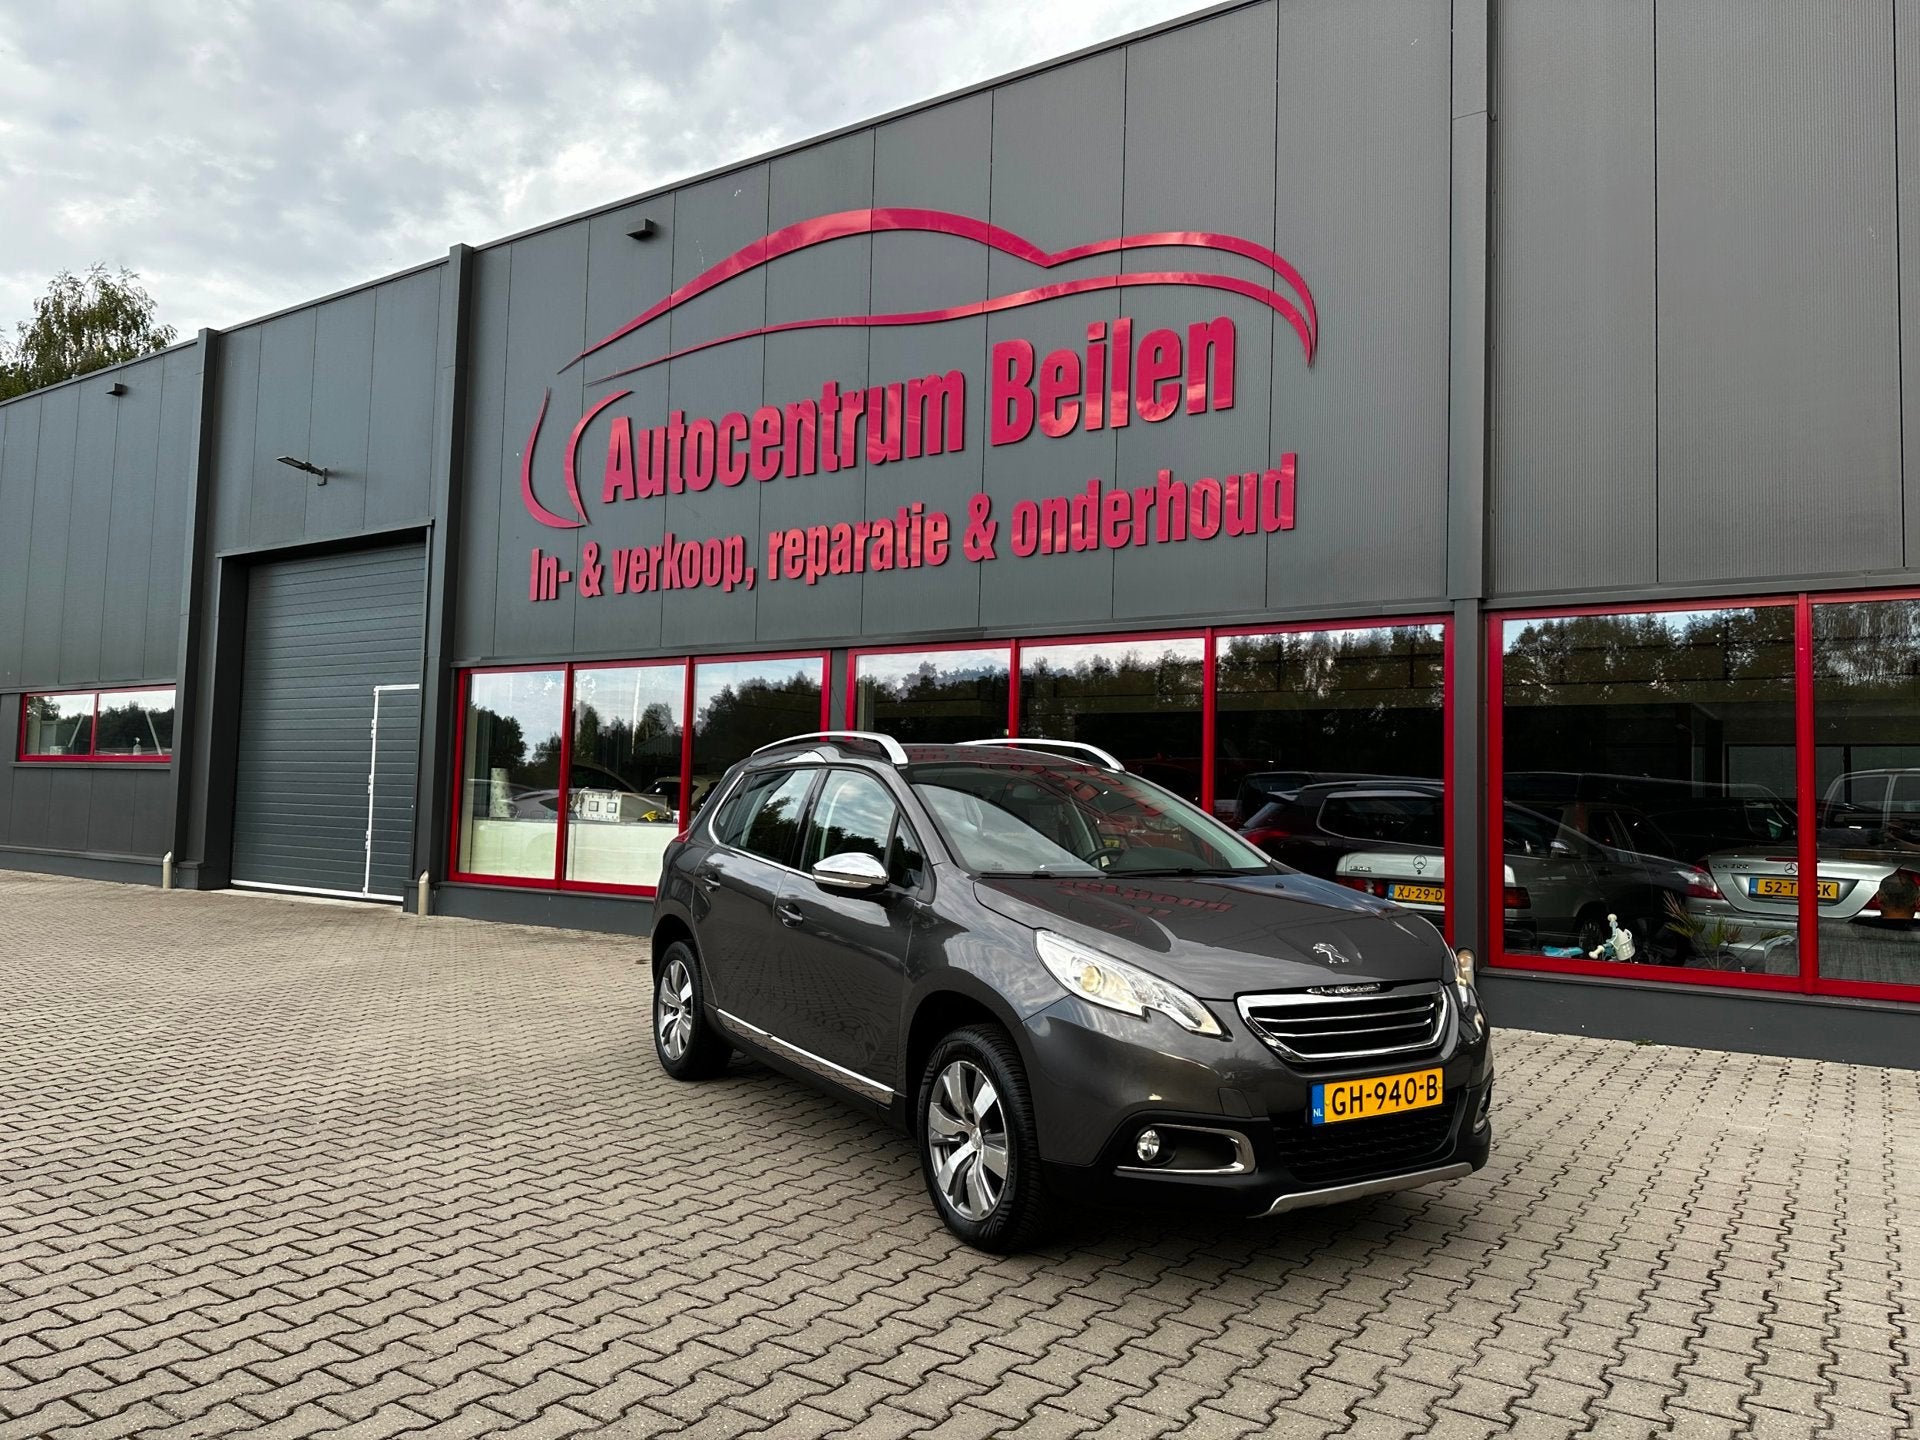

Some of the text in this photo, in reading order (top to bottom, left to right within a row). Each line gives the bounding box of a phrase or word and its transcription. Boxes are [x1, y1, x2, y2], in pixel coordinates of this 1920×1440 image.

[602, 315, 1236, 503] Autocentrum Beilen
[530, 452, 1298, 601] In- & verkoop, reparatie & onderhoud
[1397, 886, 1444, 901] XJ-29-D
[1313, 1108, 1323, 1118] NL
[1332, 1074, 1437, 1116] GH-940-B
